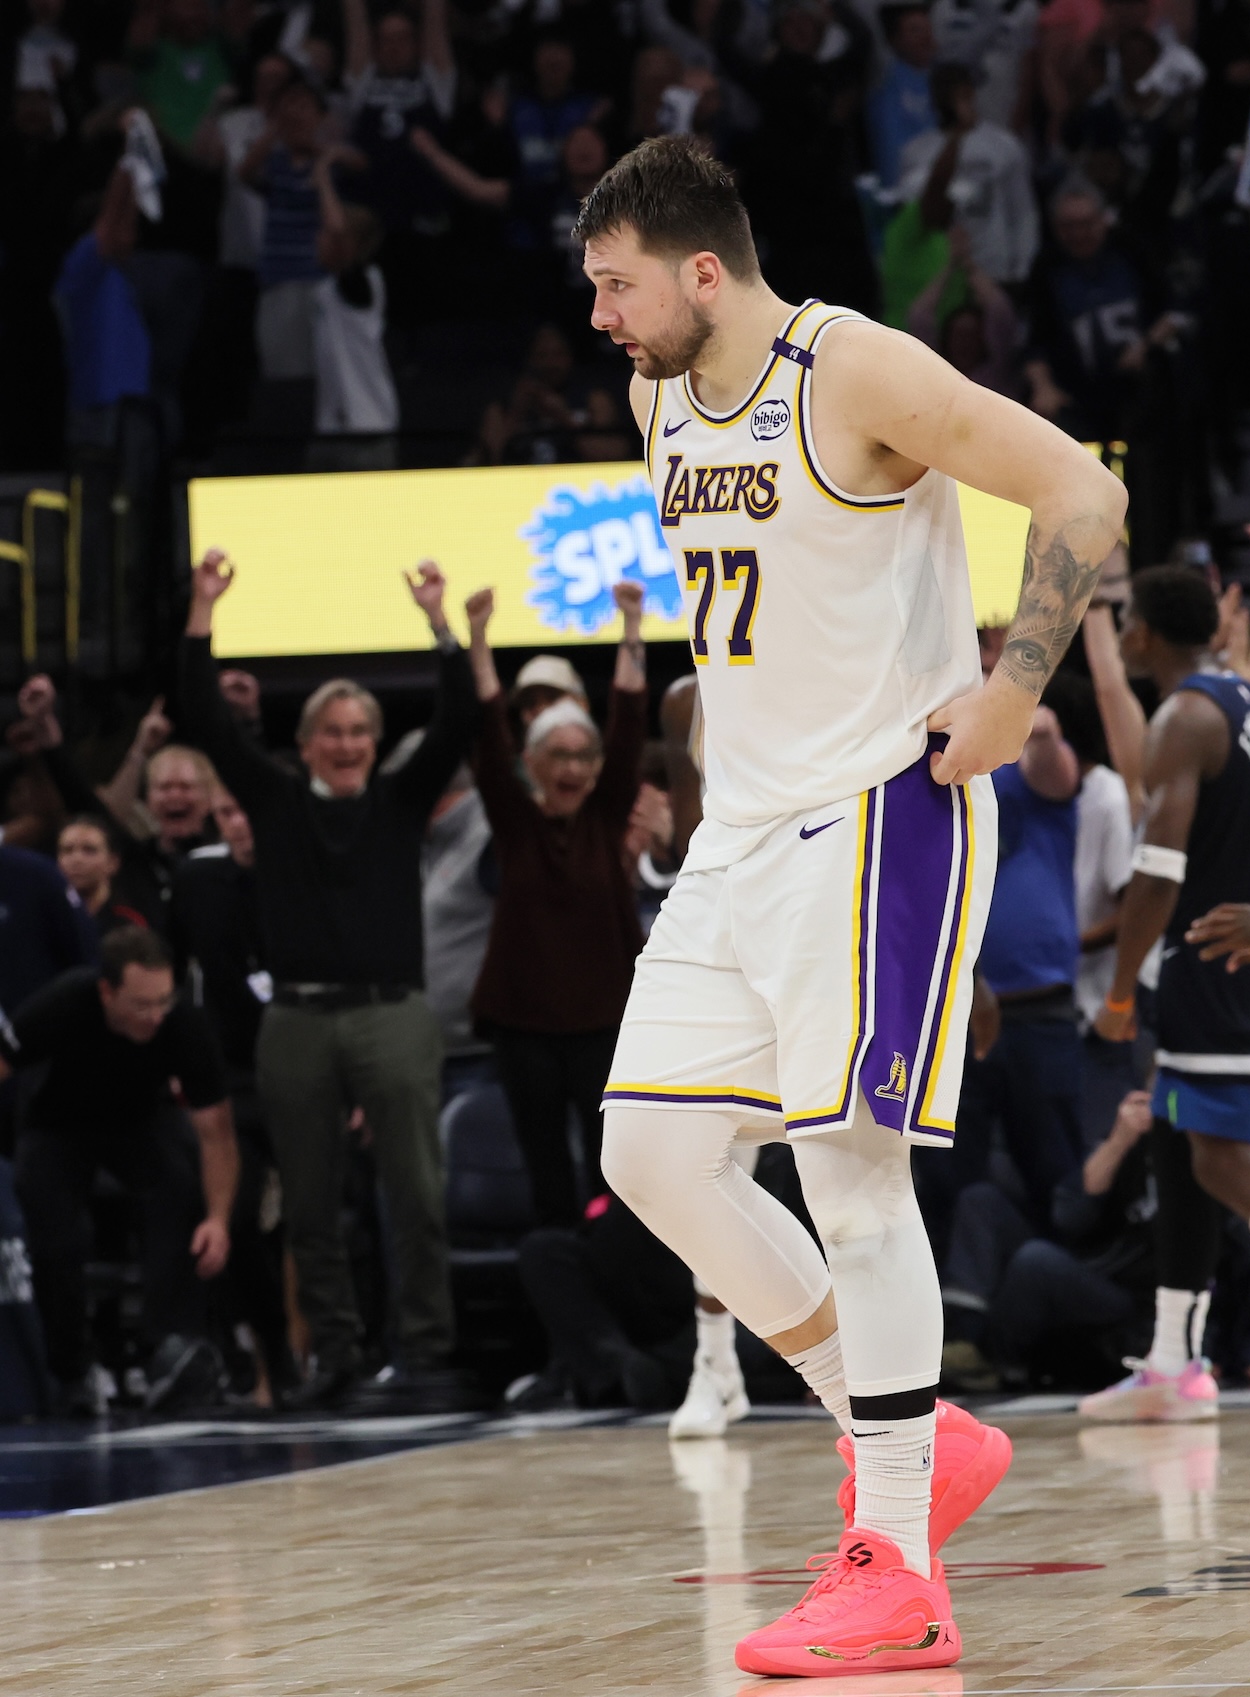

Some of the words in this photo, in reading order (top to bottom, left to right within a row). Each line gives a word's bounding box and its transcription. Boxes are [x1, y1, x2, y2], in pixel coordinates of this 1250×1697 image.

[789, 348, 800, 360] 44
[753, 410, 788, 428] bibigo
[661, 453, 782, 529] LAKERS
[682, 547, 762, 666] 77
